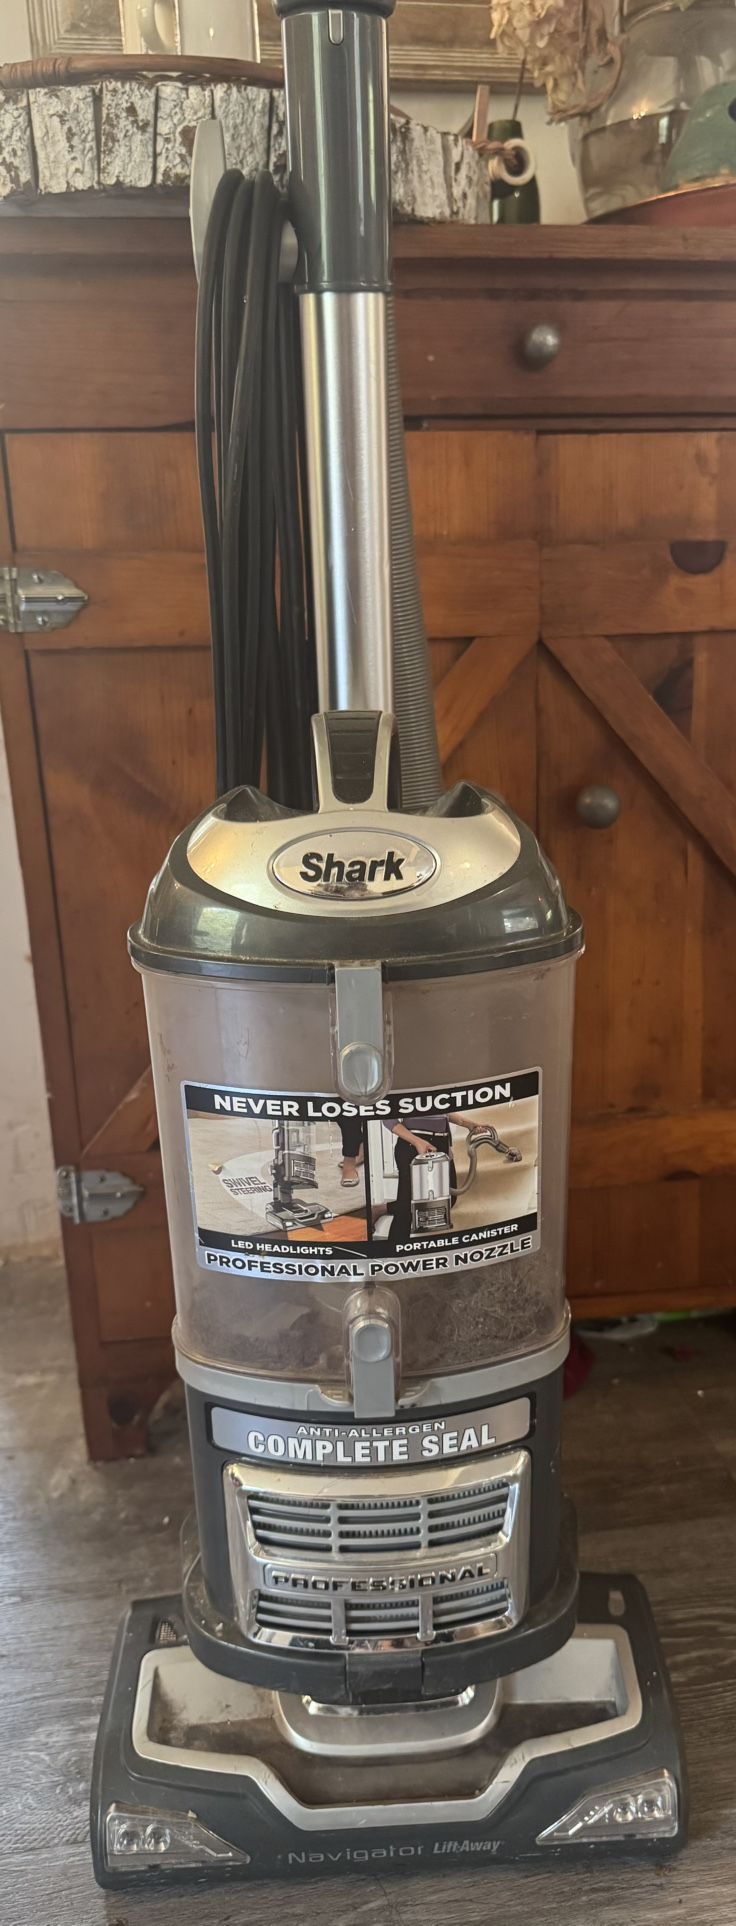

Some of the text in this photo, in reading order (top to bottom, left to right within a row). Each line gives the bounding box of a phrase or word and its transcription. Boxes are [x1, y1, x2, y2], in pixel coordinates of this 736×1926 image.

[300, 851, 405, 883] Shark
[214, 1082, 511, 1118] NEVER LOSES SUCTION
[222, 1176, 266, 1188] SWIVEL
[230, 1185, 273, 1196] STEERING
[231, 1239, 333, 1255] LED HEADLIGHTS
[396, 1224, 518, 1252] PORTABLE CANISTER
[206, 1237, 533, 1278] PROFESSIONAL POWER NOZZLE
[247, 1424, 496, 1463] COMPLETE SEAL
[297, 1421, 446, 1438] ANTI-ALLERGEN
[271, 1563, 490, 1592] PROFESSIONAL
[288, 1844, 424, 1864] Navigator
